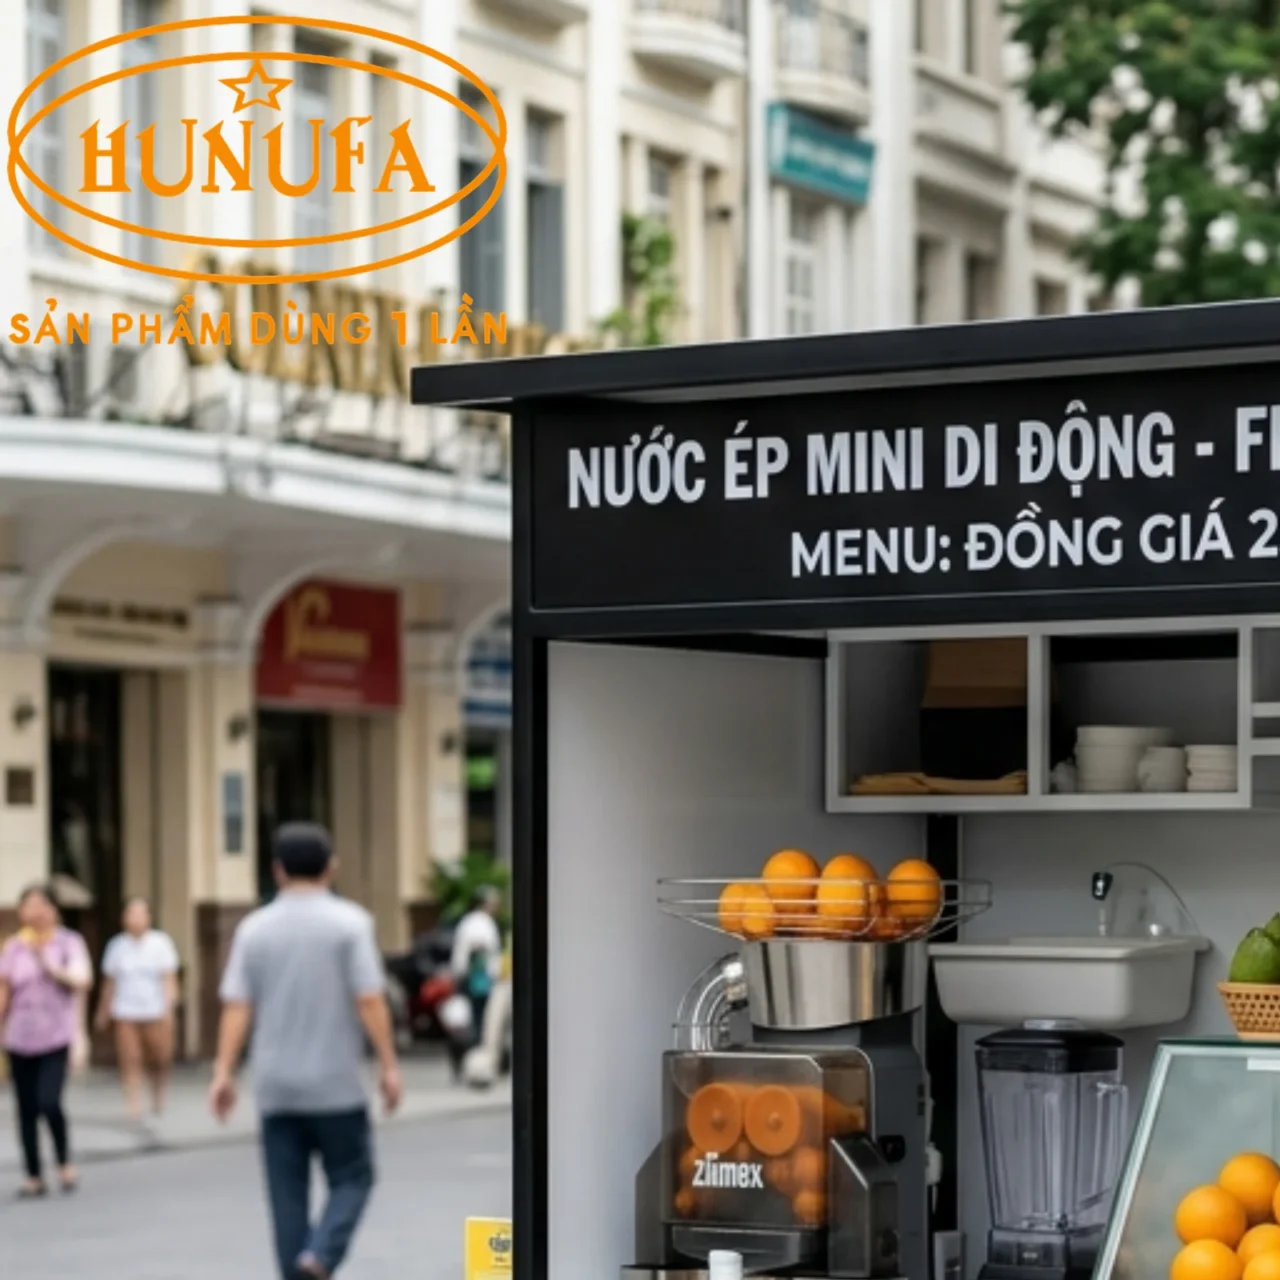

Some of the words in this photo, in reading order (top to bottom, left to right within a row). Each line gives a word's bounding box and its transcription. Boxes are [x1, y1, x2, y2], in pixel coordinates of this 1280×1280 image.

[569, 425, 706, 508] NƯỚC
[724, 420, 789, 500] ÉP
[807, 427, 923, 496] MINI
[945, 423, 997, 487] DI
[1017, 400, 1174, 497] ĐỘNG
[792, 526, 950, 578] MENU:
[964, 501, 1123, 571] ĐỒNG
[1139, 498, 1233, 563] GIÁ
